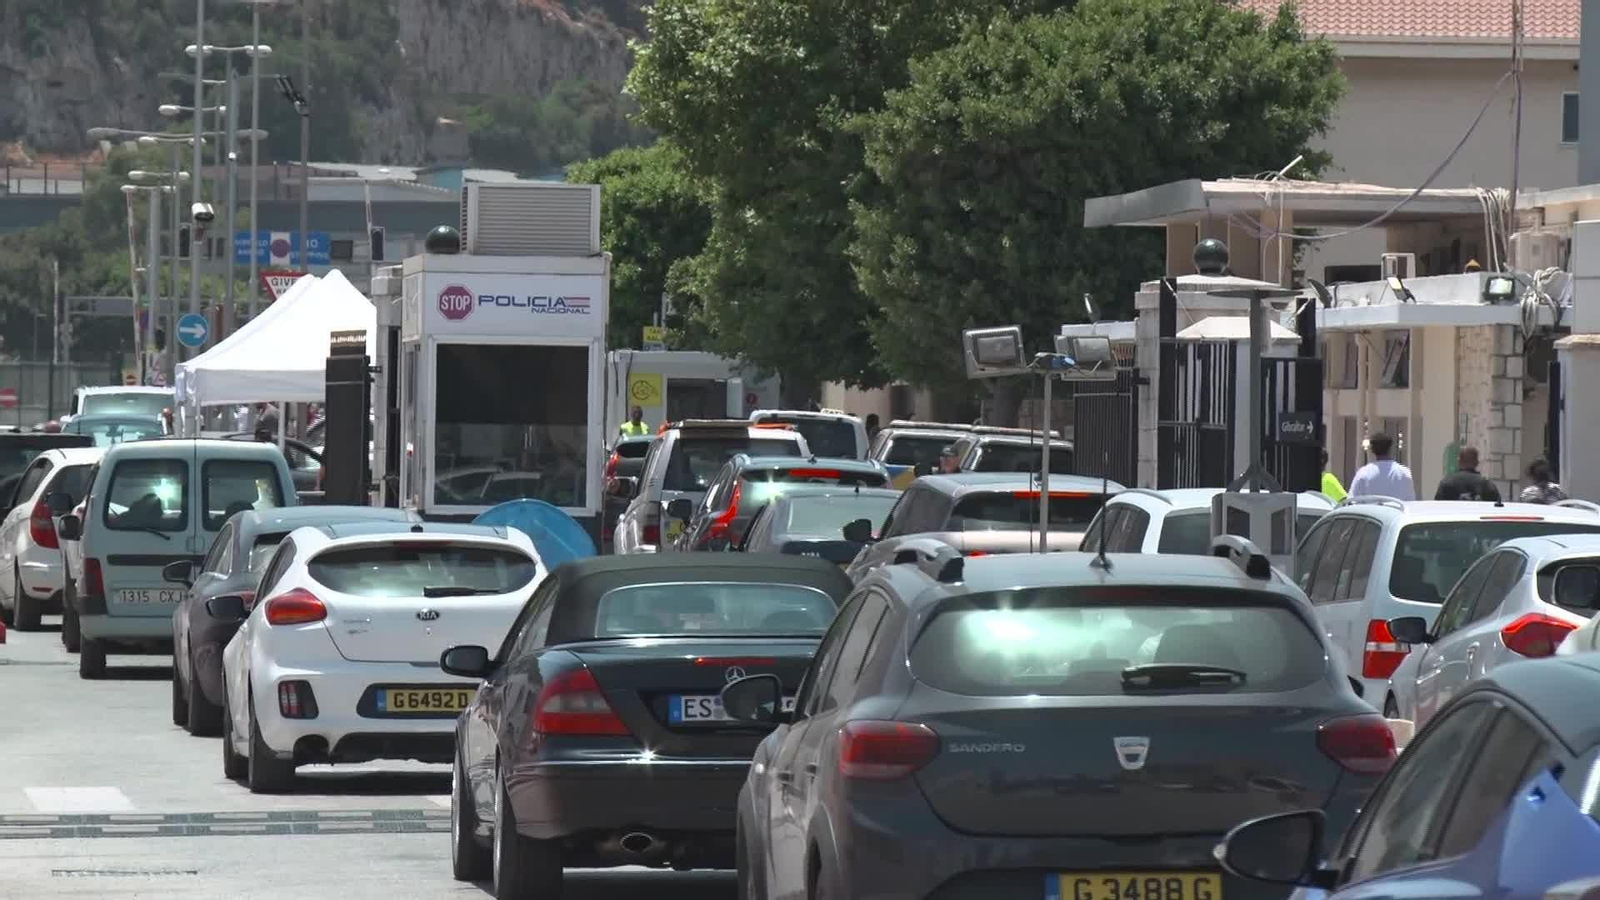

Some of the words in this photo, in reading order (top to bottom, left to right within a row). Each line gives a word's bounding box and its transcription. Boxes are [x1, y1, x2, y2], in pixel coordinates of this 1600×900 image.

[440, 294, 471, 311] STOP
[478, 295, 567, 307] POLICIA
[121, 590, 150, 603] 1315
[419, 610, 438, 619] KIA
[949, 742, 1025, 753] SANDERO
